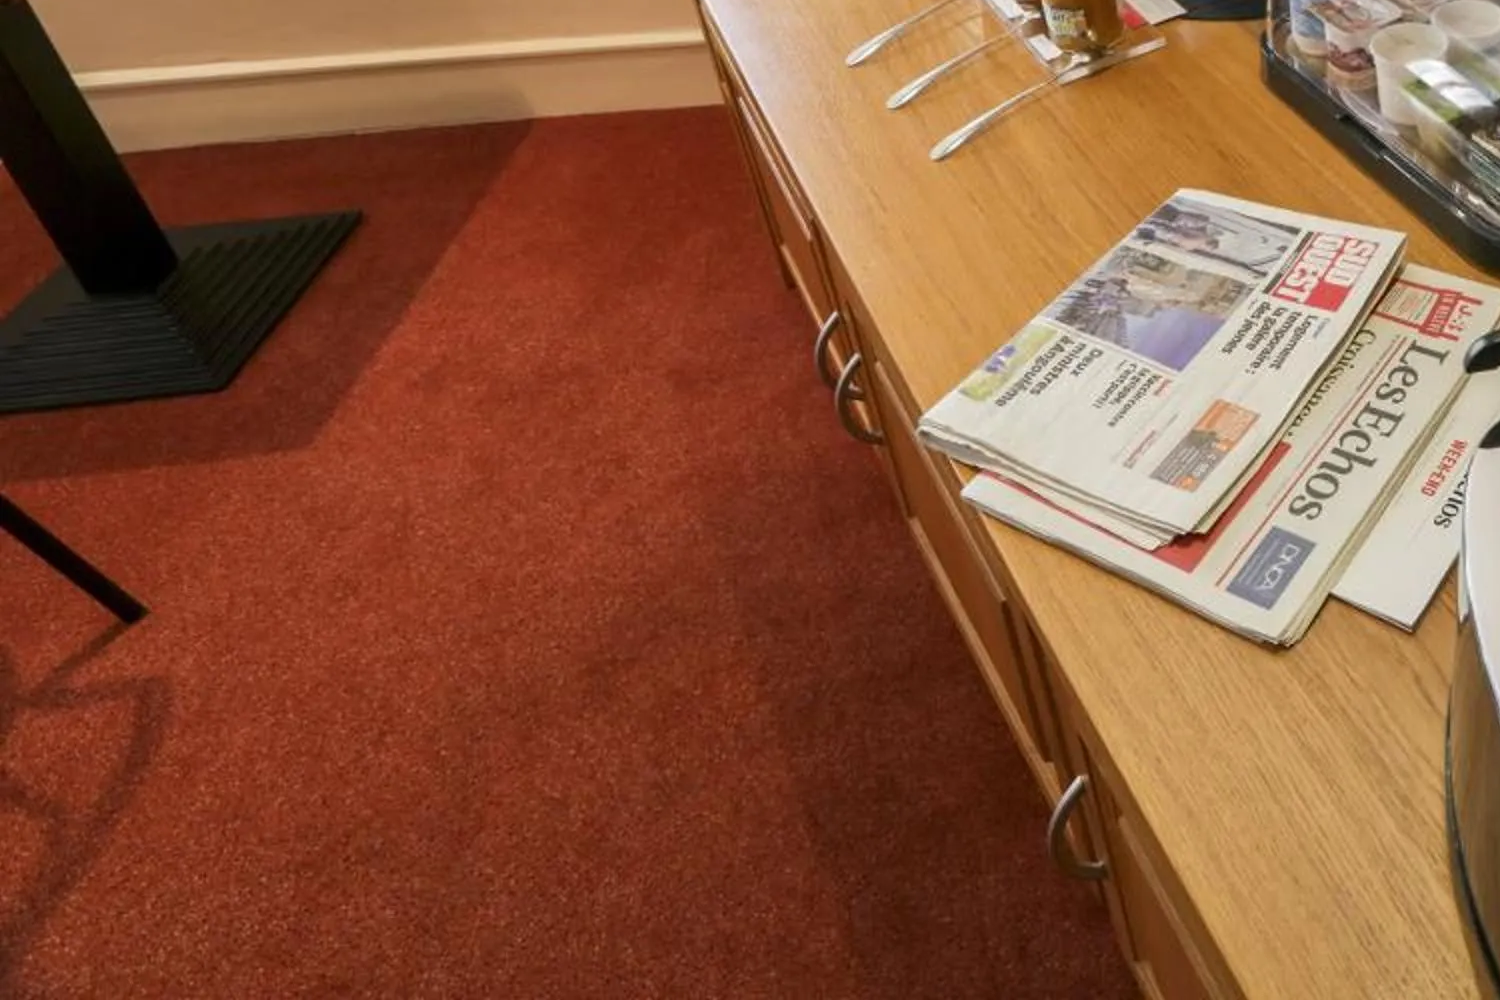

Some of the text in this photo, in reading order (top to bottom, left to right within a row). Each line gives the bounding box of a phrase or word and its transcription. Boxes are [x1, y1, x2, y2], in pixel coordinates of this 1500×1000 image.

[1273, 234, 1345, 303] OUEST
[1325, 238, 1378, 286] SUD
[1223, 302, 1273, 354] des jeunes
[1271, 315, 1316, 369] Logement
[1030, 343, 1087, 395] ministres
[1071, 349, 1102, 377] Deux
[1422, 439, 1467, 497] WEEK-END
[1262, 543, 1298, 588] DNCA
